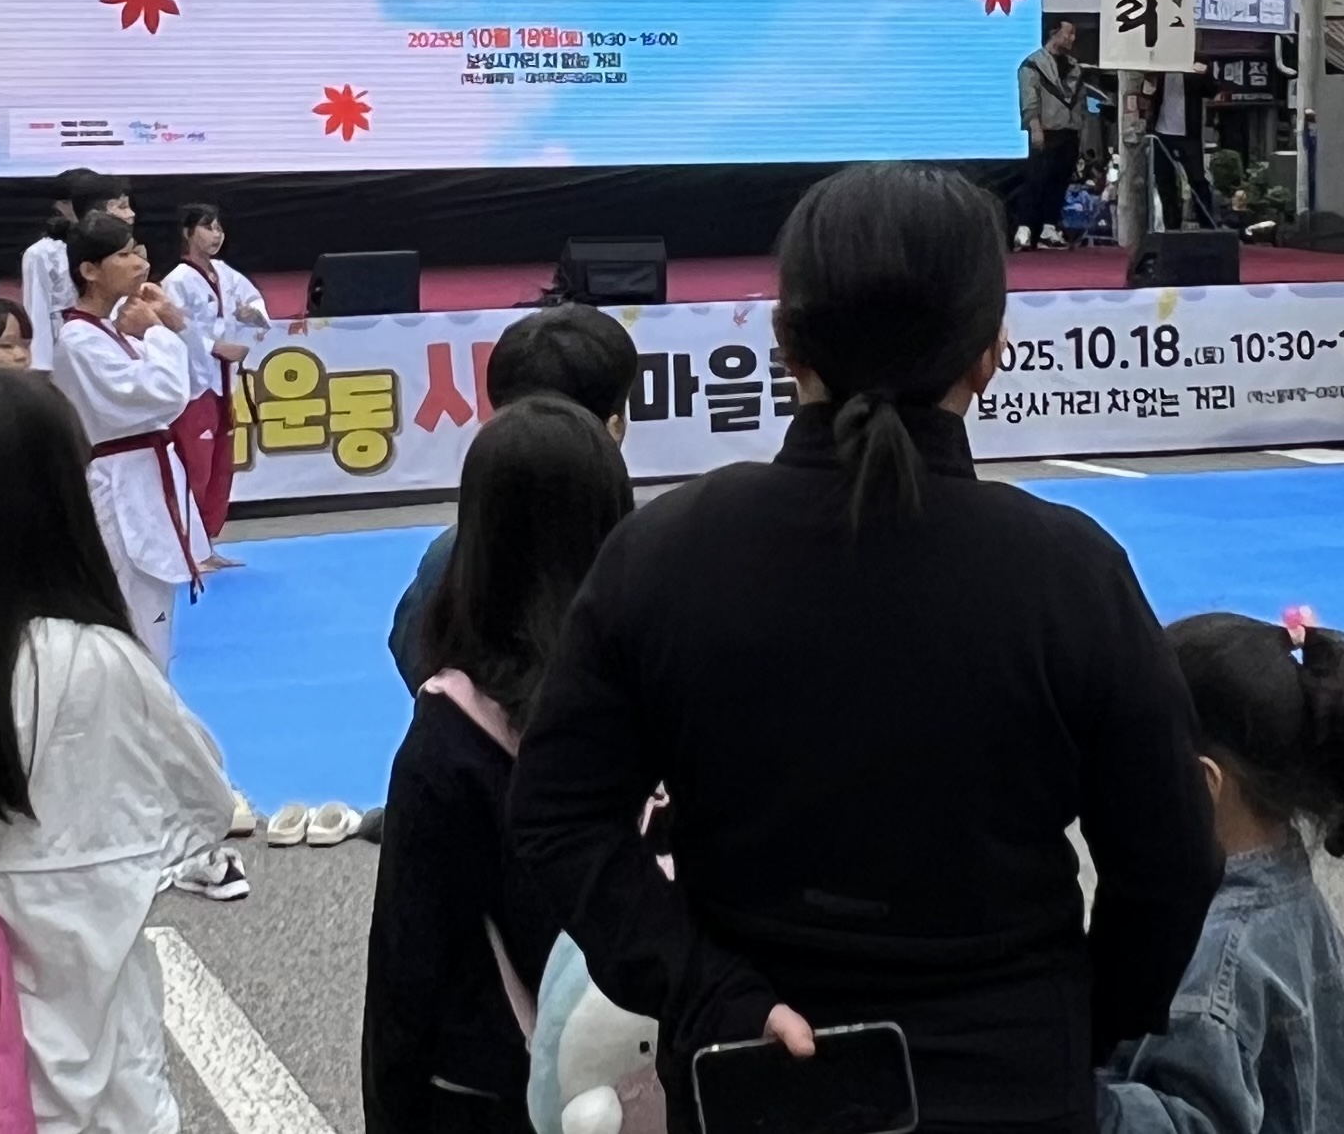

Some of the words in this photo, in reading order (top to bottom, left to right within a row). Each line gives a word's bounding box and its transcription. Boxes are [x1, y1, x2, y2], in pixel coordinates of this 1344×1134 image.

[628, 344, 798, 435] 마을
[976, 389, 1100, 425] 보성사거리
[1193, 384, 1236, 412] 거리
